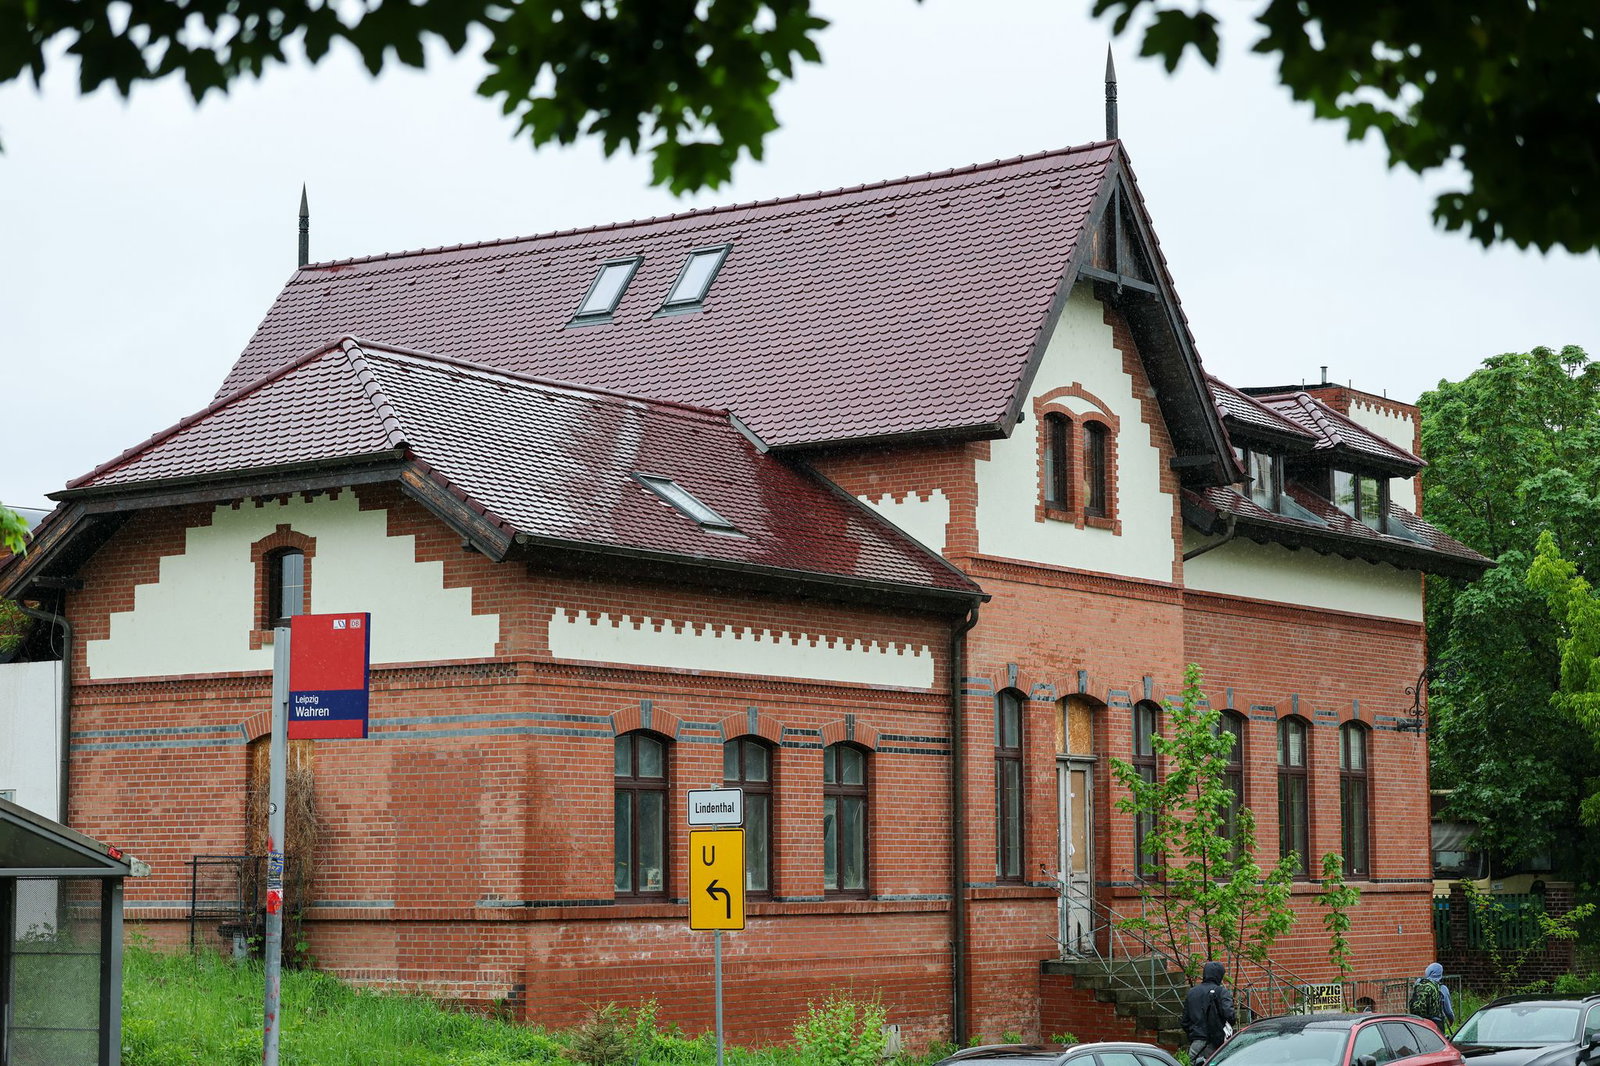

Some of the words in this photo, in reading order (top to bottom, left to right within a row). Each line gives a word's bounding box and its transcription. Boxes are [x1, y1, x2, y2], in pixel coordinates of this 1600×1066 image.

[295, 694, 319, 705] Leipzig
[295, 706, 330, 717] Wahren
[695, 802, 735, 814] Lindenthal
[702, 845, 715, 867] U
